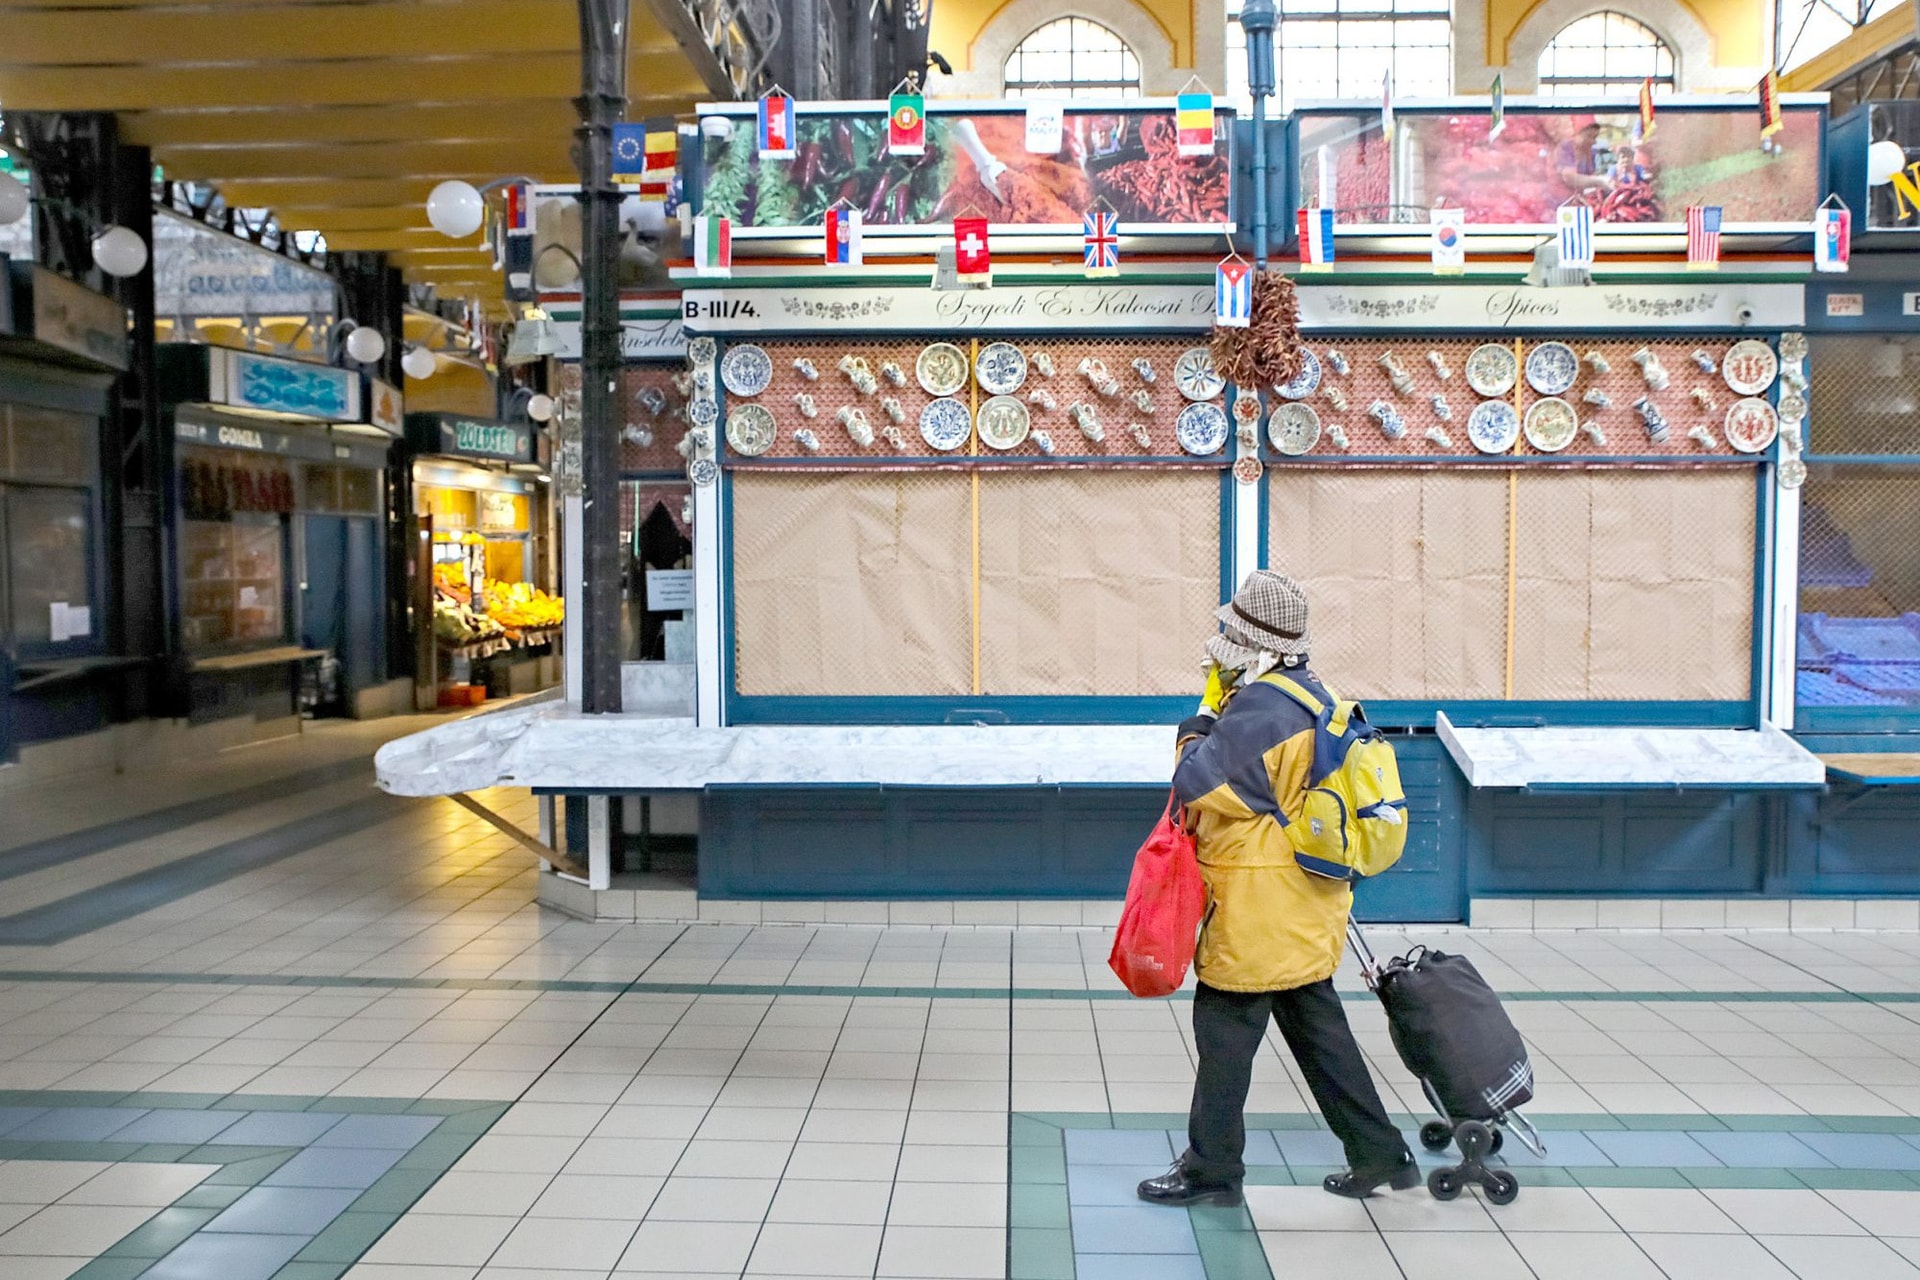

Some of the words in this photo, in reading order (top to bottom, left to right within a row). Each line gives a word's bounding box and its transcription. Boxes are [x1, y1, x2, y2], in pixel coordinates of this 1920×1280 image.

[685, 300, 761, 319] B-III/4.
[936, 290, 1026, 326] Szegedi
[1035, 285, 1073, 316] És
[1080, 288, 1184, 315] Kalocsai
[1485, 287, 1560, 326] Spices
